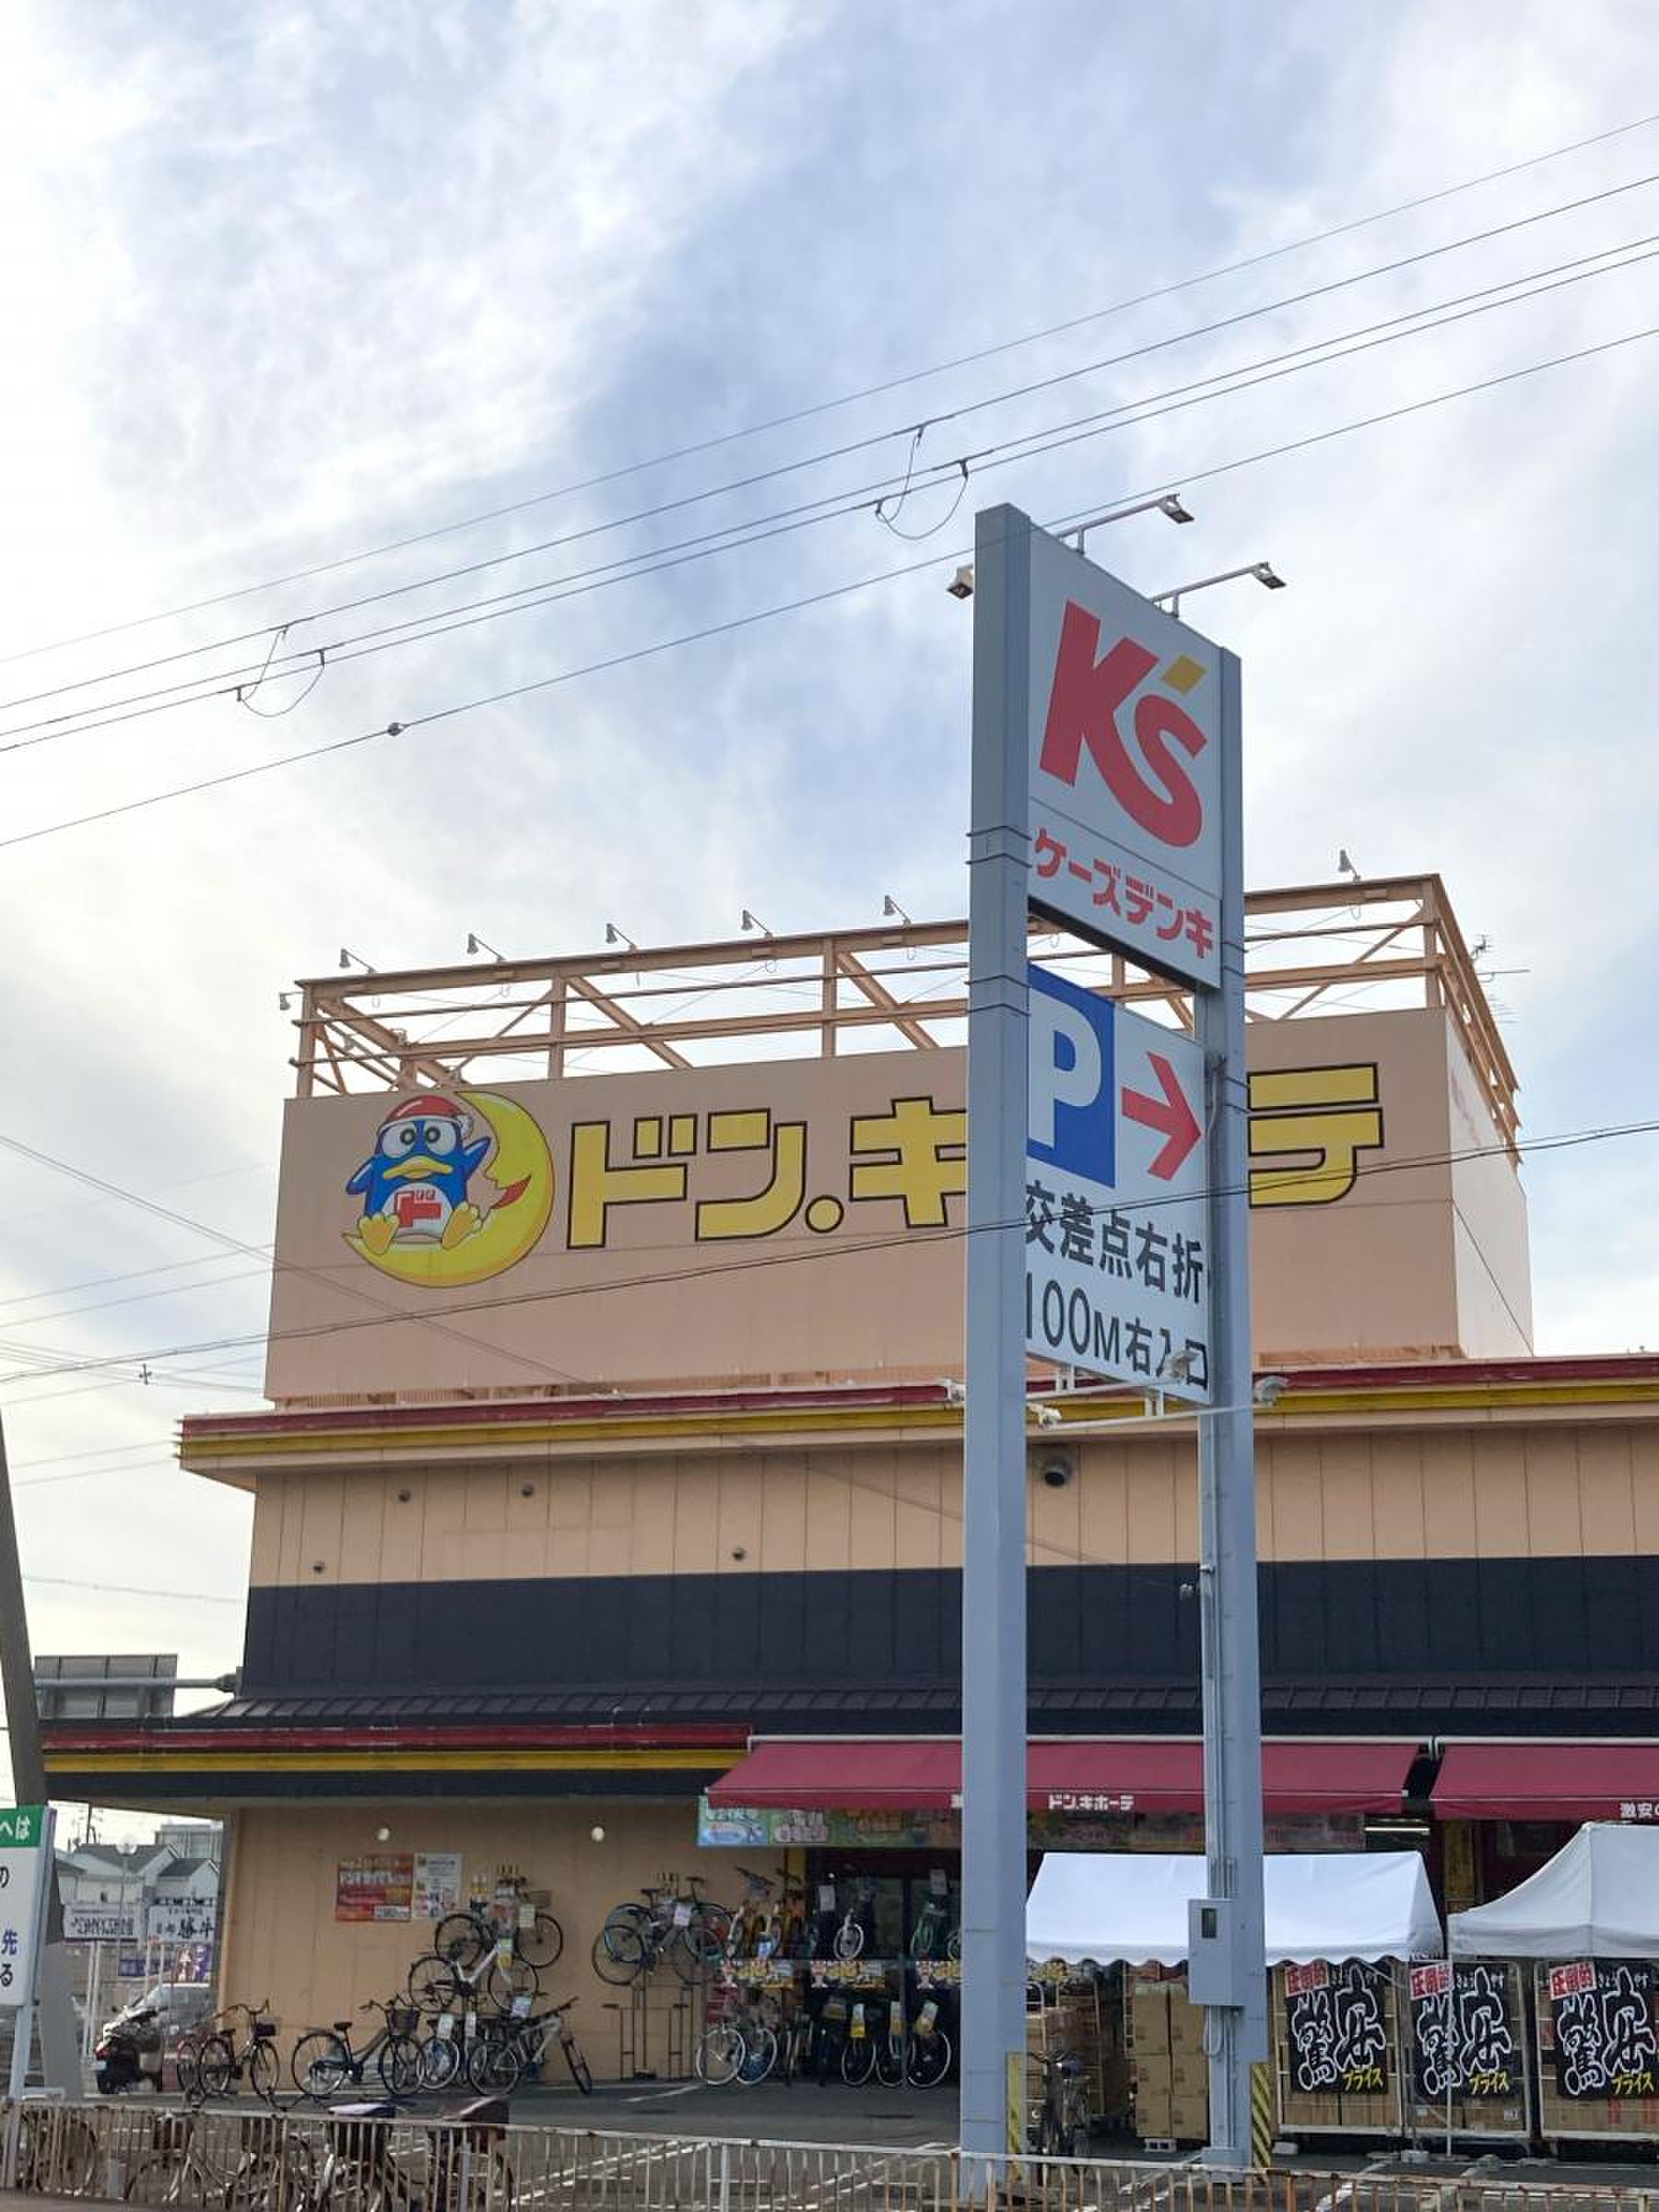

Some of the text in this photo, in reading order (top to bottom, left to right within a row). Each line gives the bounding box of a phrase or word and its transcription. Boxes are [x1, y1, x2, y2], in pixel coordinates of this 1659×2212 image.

[1033, 826, 1214, 959] ケーズデンキ
[1029, 990, 1102, 1151] P
[1025, 1179, 1204, 1304] 交差点右折
